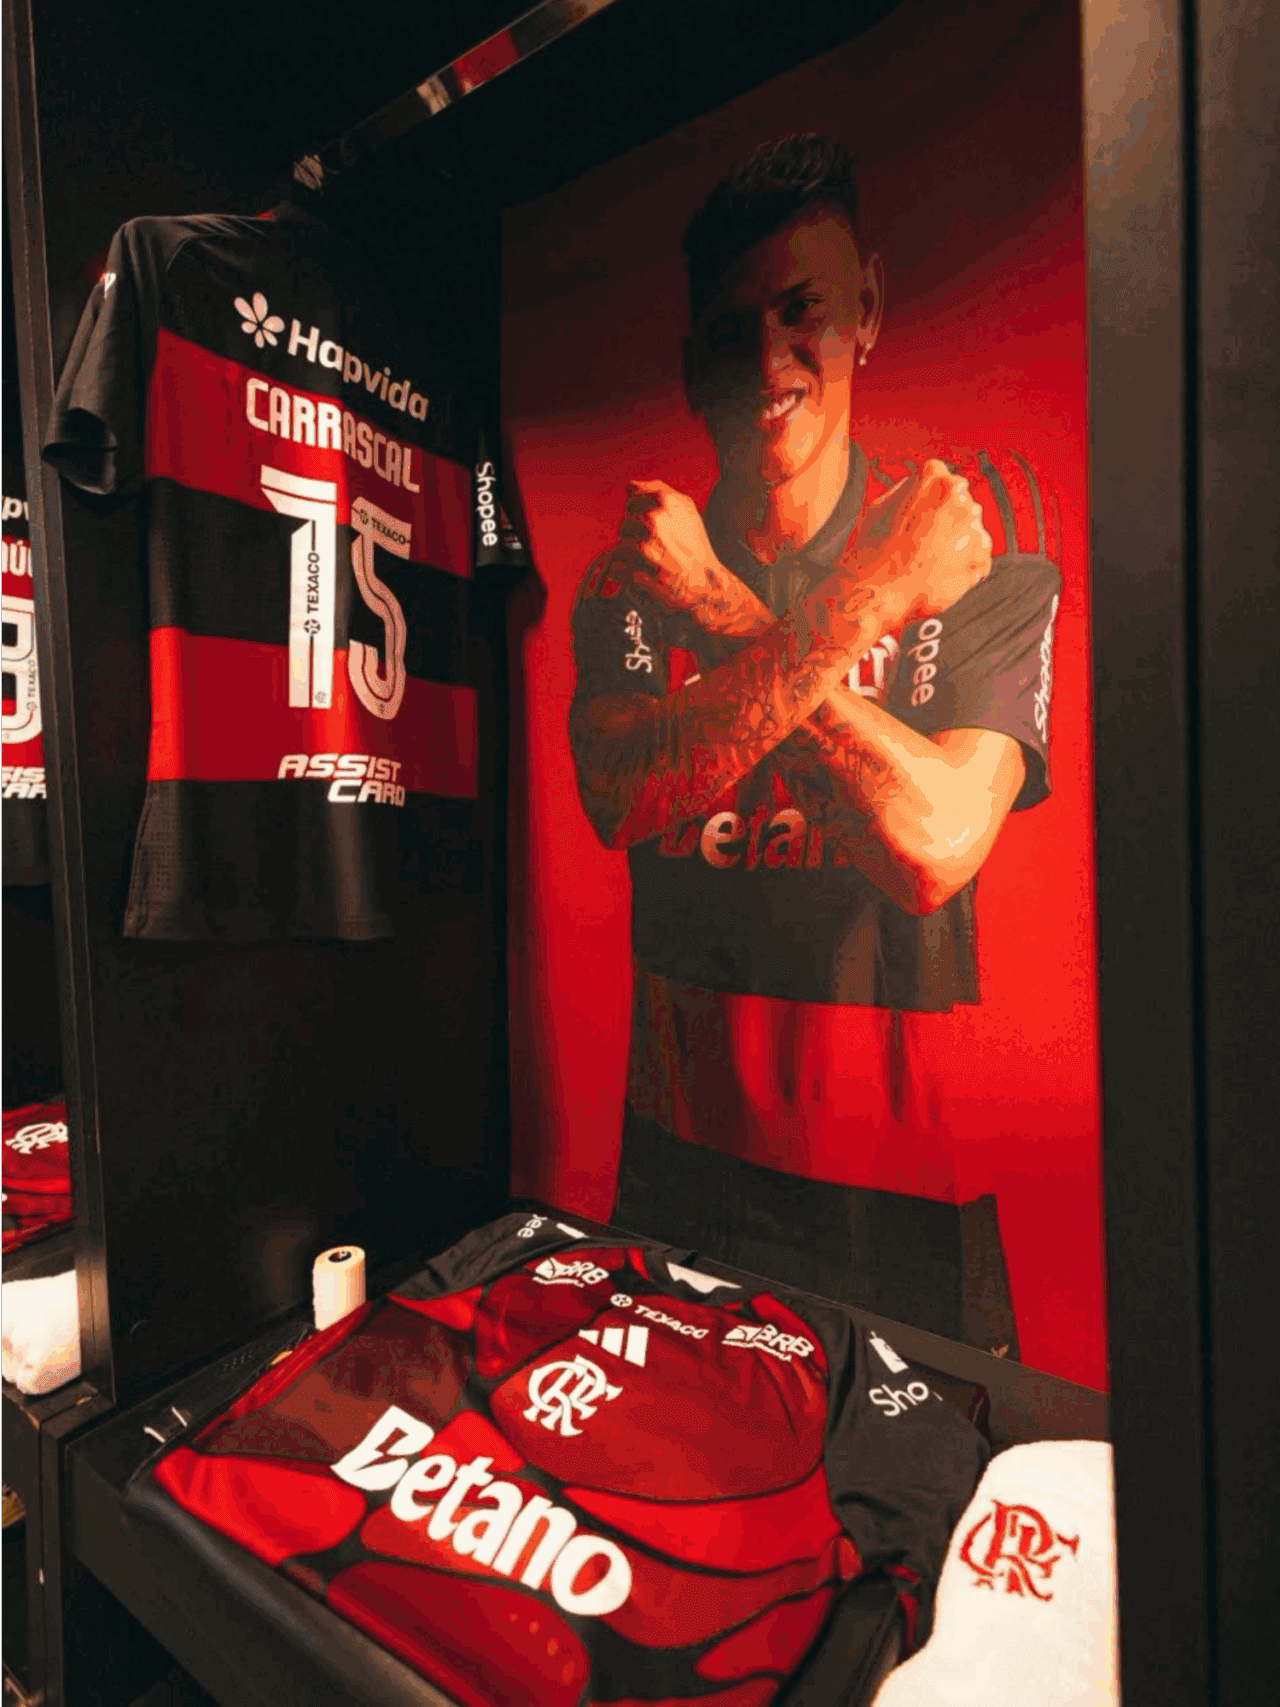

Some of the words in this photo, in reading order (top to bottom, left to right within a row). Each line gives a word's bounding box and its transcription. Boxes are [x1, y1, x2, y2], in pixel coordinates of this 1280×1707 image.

[287, 318, 429, 422] Hapvida
[246, 377, 420, 493] CARRASCAL
[371, 516, 406, 545] TEXACO
[475, 461, 498, 547] Shopee
[261, 464, 411, 720] 15
[307, 552, 320, 614] TEXACO
[911, 618, 943, 707] opee
[277, 753, 401, 782] ASSIST
[327, 779, 405, 807] CARD
[634, 1304, 710, 1339] TEXACO
[757, 1323, 815, 1358] BRB
[868, 1381, 943, 1417] Sho
[330, 1404, 633, 1616] Betano
